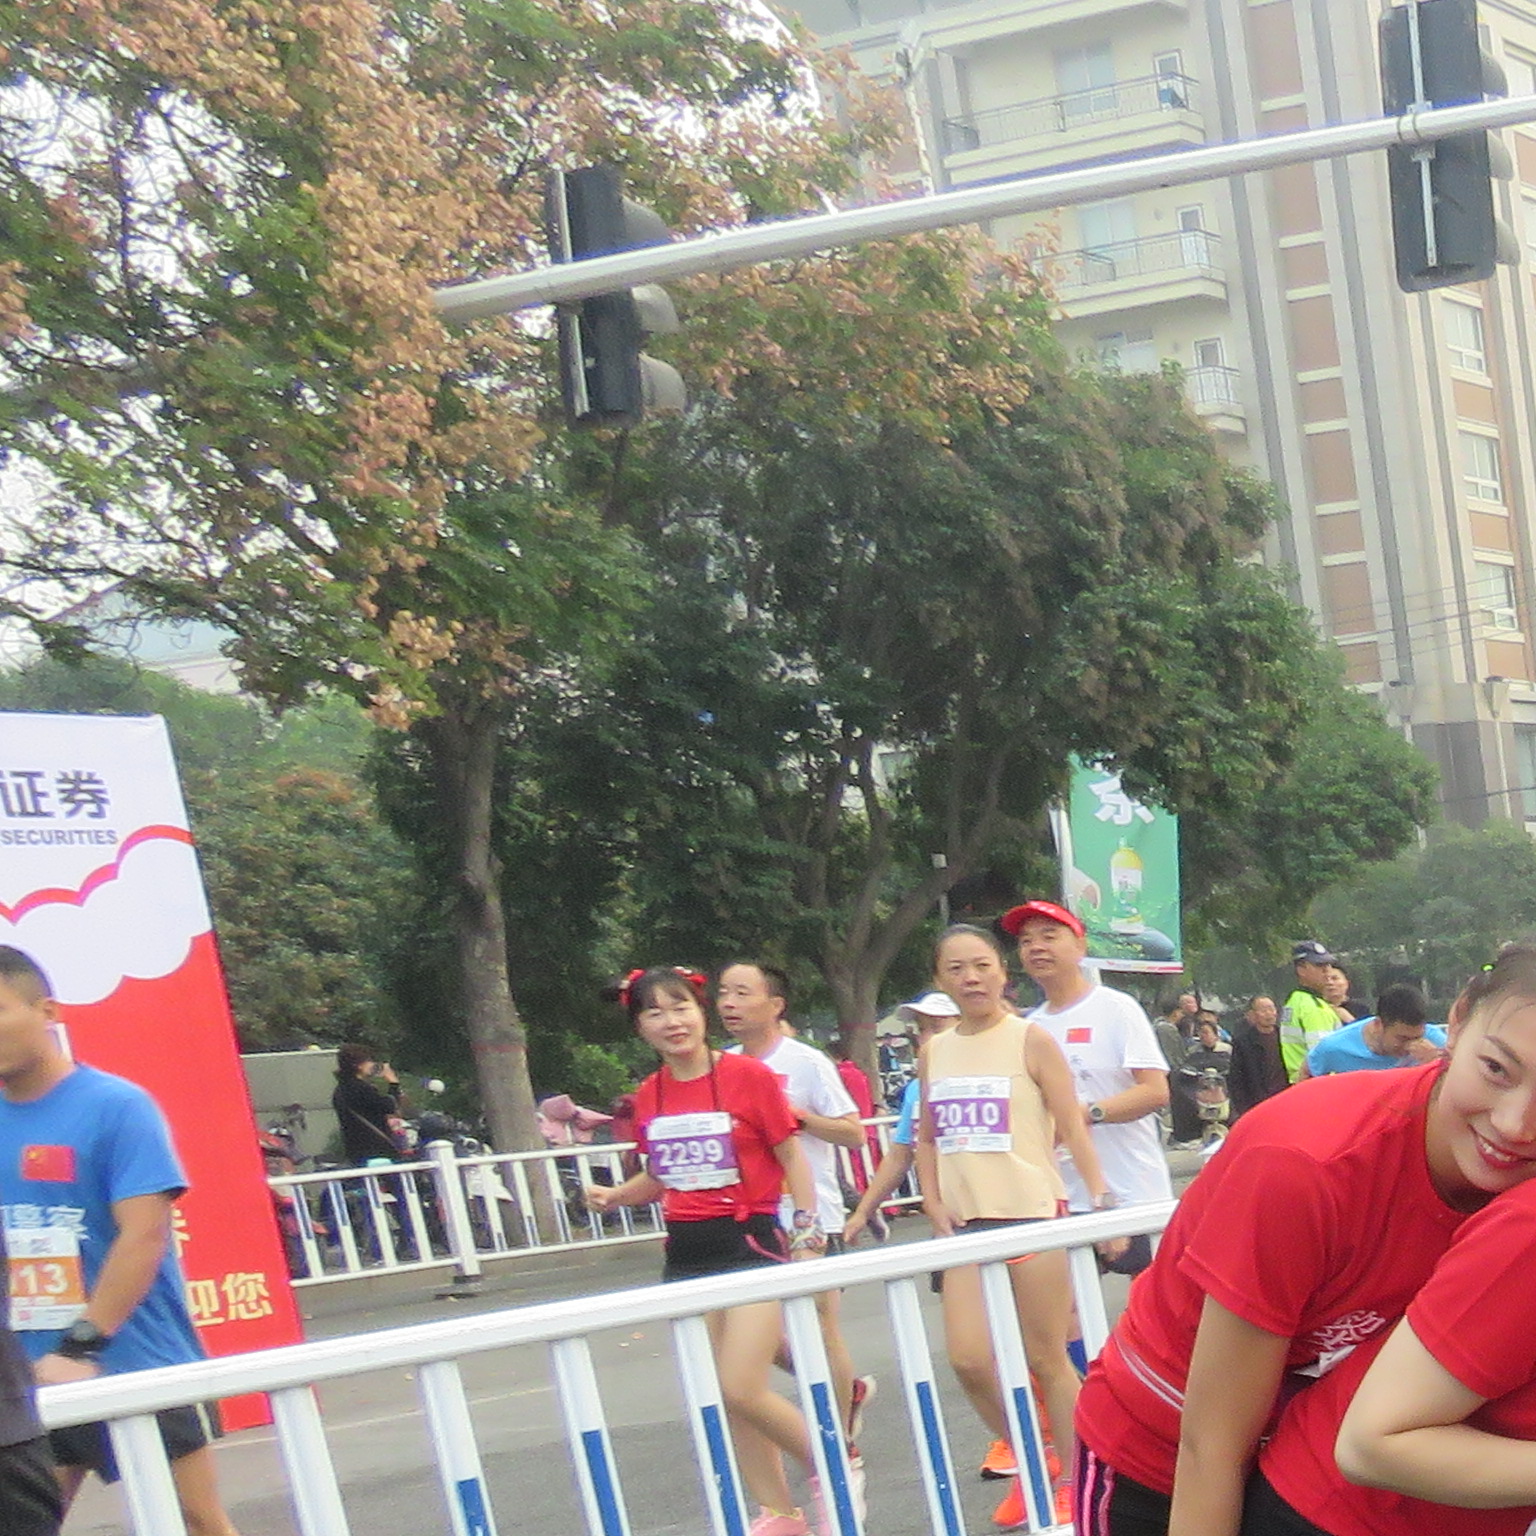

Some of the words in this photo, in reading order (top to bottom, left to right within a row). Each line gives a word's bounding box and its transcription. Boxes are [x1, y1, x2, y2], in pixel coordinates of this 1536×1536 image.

[0, 769, 110, 819] 证券
[1, 829, 120, 845] SECURITIES
[935, 1102, 1000, 1128] 2010
[654, 1139, 725, 1167] 2299
